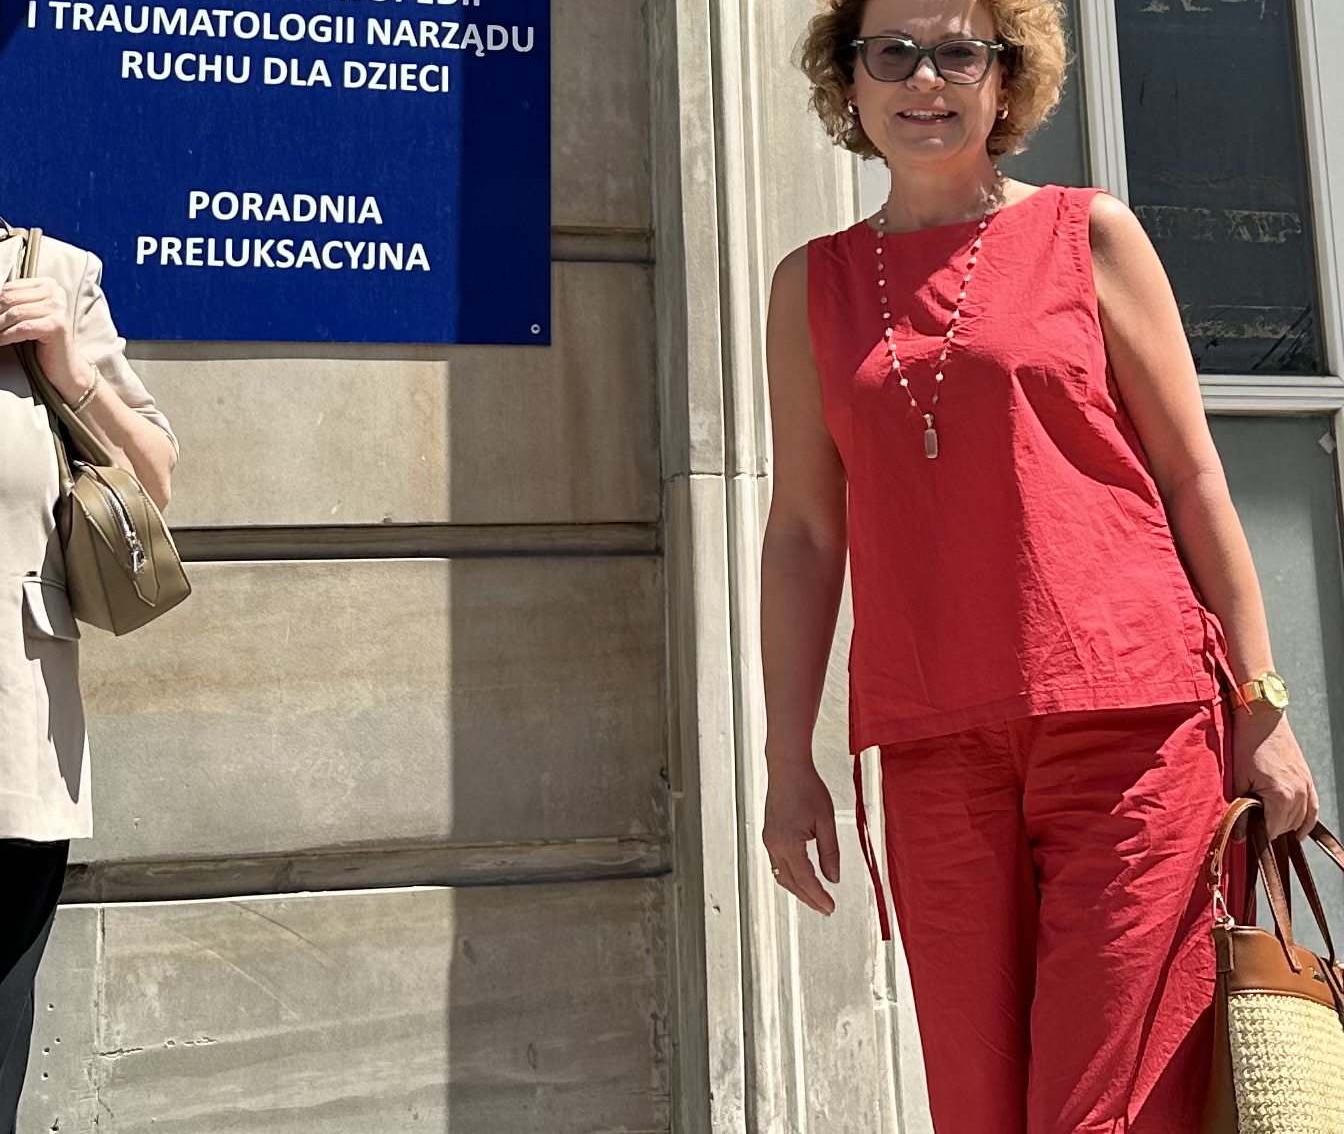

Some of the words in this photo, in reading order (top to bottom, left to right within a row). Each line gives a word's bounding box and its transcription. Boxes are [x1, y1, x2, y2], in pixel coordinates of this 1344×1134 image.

[28, 0, 36, 28] I
[49, 1, 354, 44] TRAUMATOLOGII
[367, 19, 534, 57] NARZĄDU
[121, 51, 250, 84] RUCHU
[264, 57, 331, 87] DLA
[343, 61, 449, 92] DZIECI
[189, 191, 383, 225] PORADNIA
[136, 236, 430, 272] PRELUKSACYJNA
